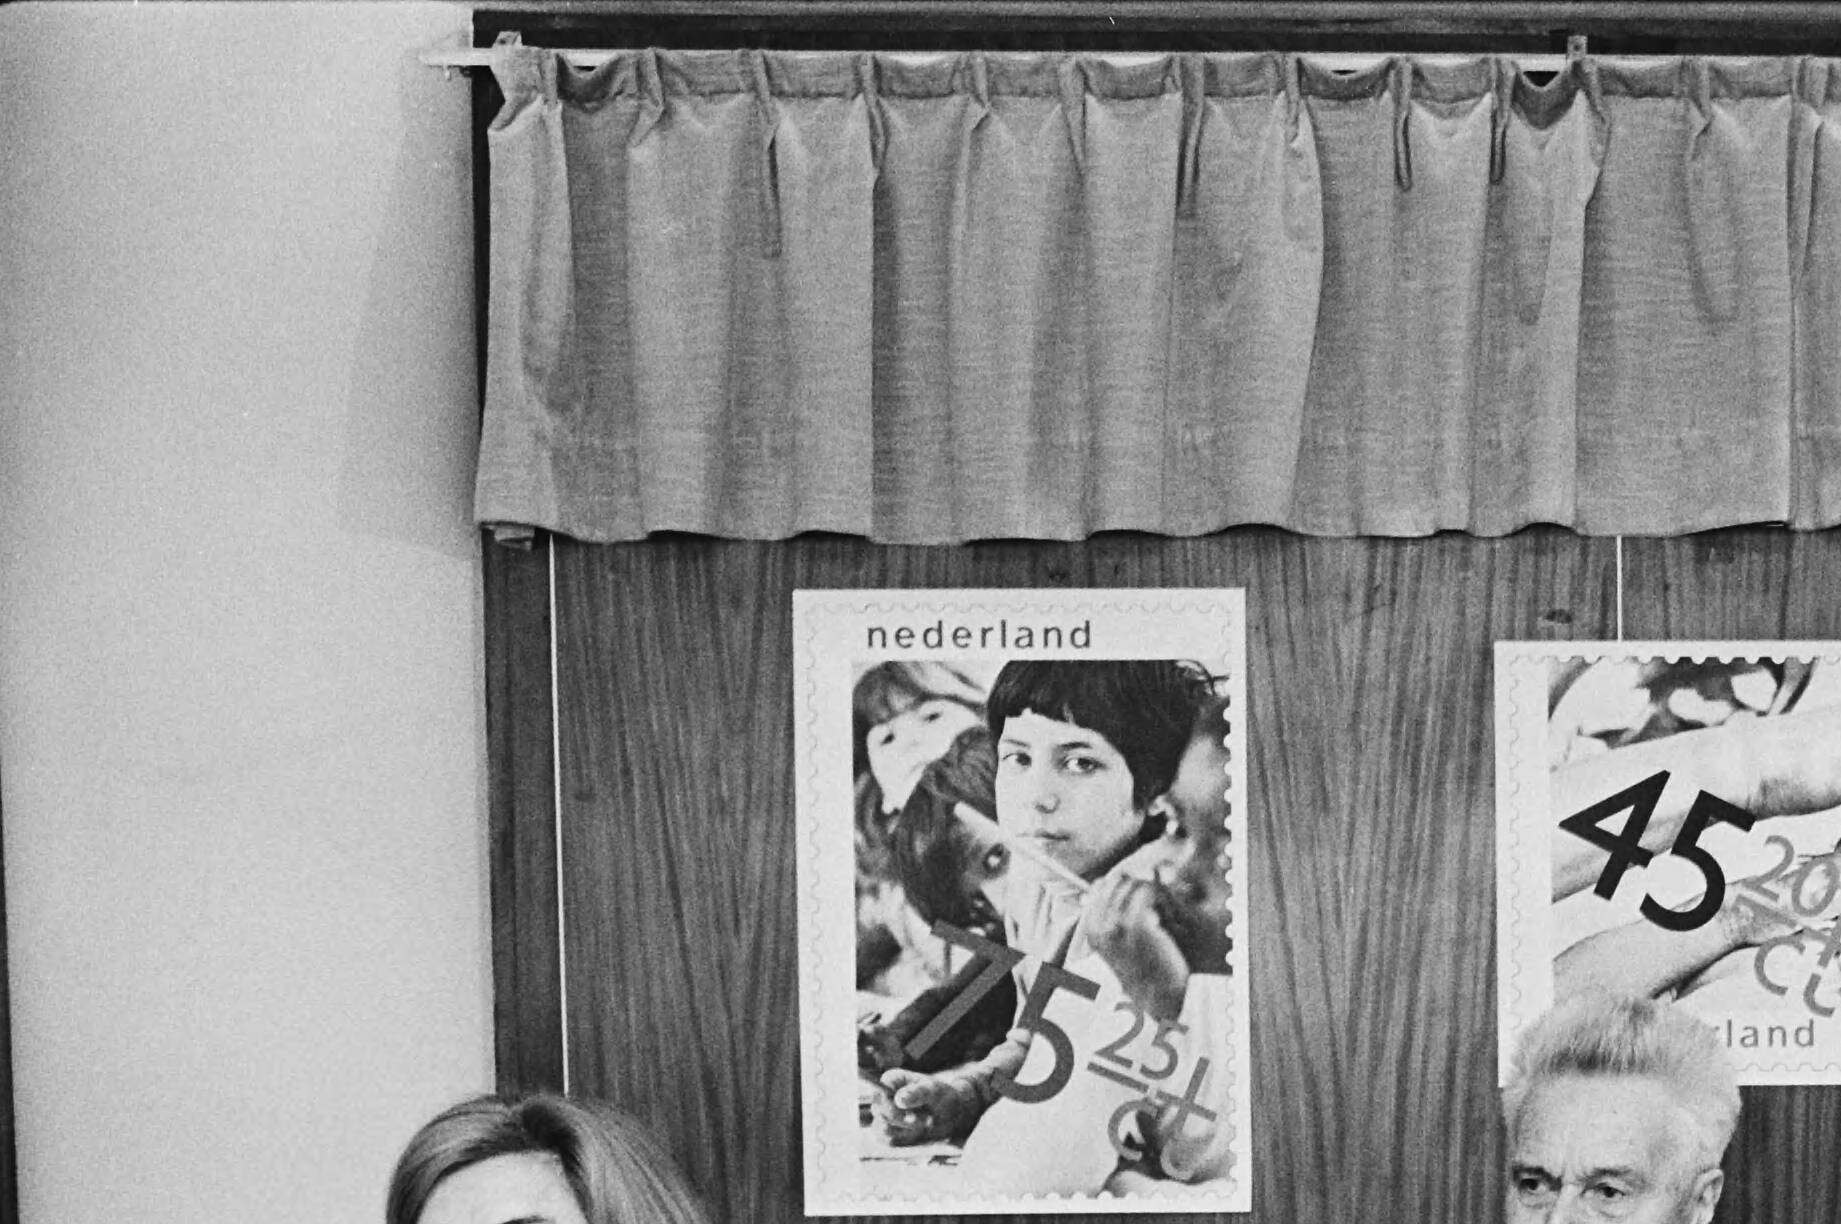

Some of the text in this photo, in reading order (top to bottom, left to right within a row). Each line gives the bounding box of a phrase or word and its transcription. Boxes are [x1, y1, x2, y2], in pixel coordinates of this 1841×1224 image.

[867, 619, 1091, 649] nederland
[1558, 769, 1840, 932] 45 20
[904, 919, 1190, 1104] 75 25
[1714, 1018, 1815, 1048] land
